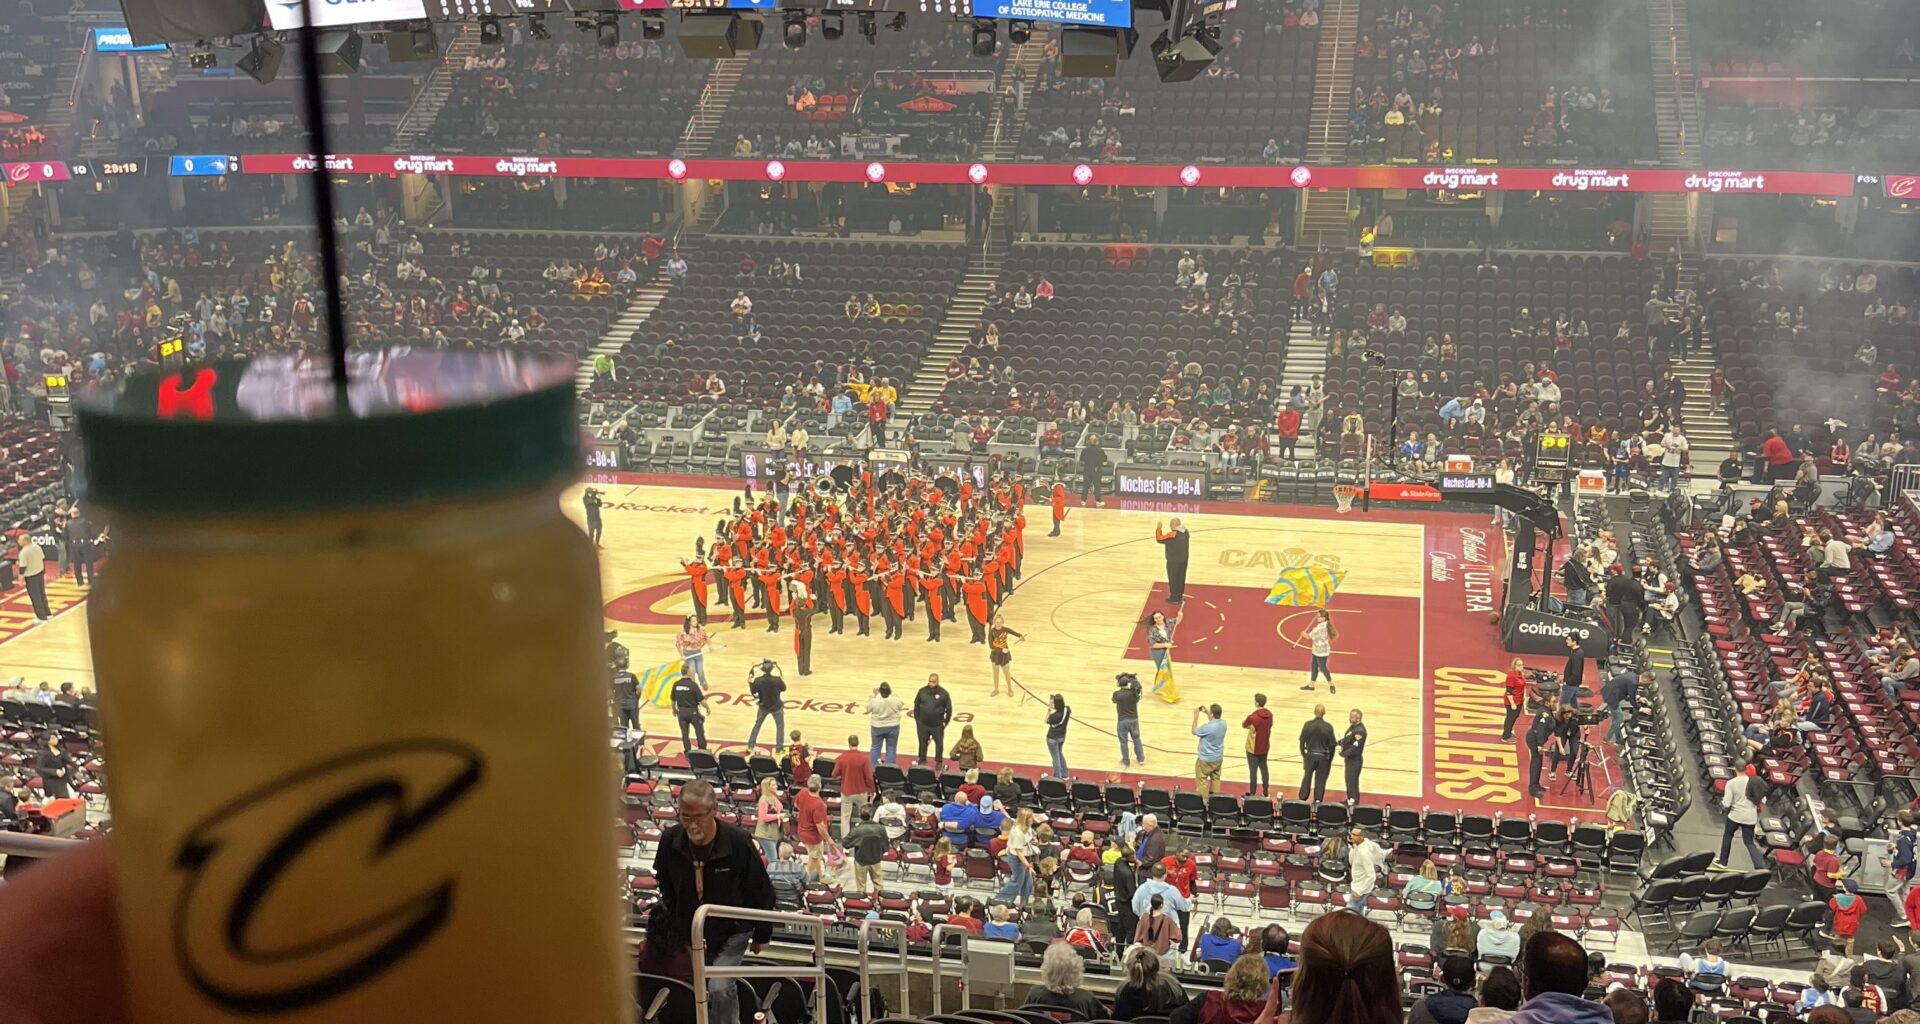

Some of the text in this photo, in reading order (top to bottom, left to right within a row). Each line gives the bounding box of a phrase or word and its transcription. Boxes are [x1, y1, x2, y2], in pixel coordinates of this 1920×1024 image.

[998, 6, 1105, 22] OF OSTEOPATHIC MEDICINE
[1034, 0, 1051, 8] ERIE
[1052, 1, 1087, 12] COLLEGE
[43, 165, 53, 177] 0
[104, 163, 138, 174] 29:18
[185, 159, 194, 172] 0
[325, 158, 353, 170] mart
[394, 157, 454, 173] drug mart
[496, 159, 557, 176] drug mart
[1424, 171, 1498, 188] drug mart
[1552, 172, 1629, 190] drug mart
[1685, 174, 1764, 192] drug mart
[1857, 175, 1878, 184] FG%
[1120, 475, 1155, 494] Noches
[1443, 477, 1465, 489] Noches
[616, 502, 710, 515] Rocket
[1218, 547, 1342, 573] CAVS
[1464, 571, 1494, 613] ULTRA
[733, 693, 861, 716] Rcket
[1434, 666, 1522, 804] CAVALIERS
